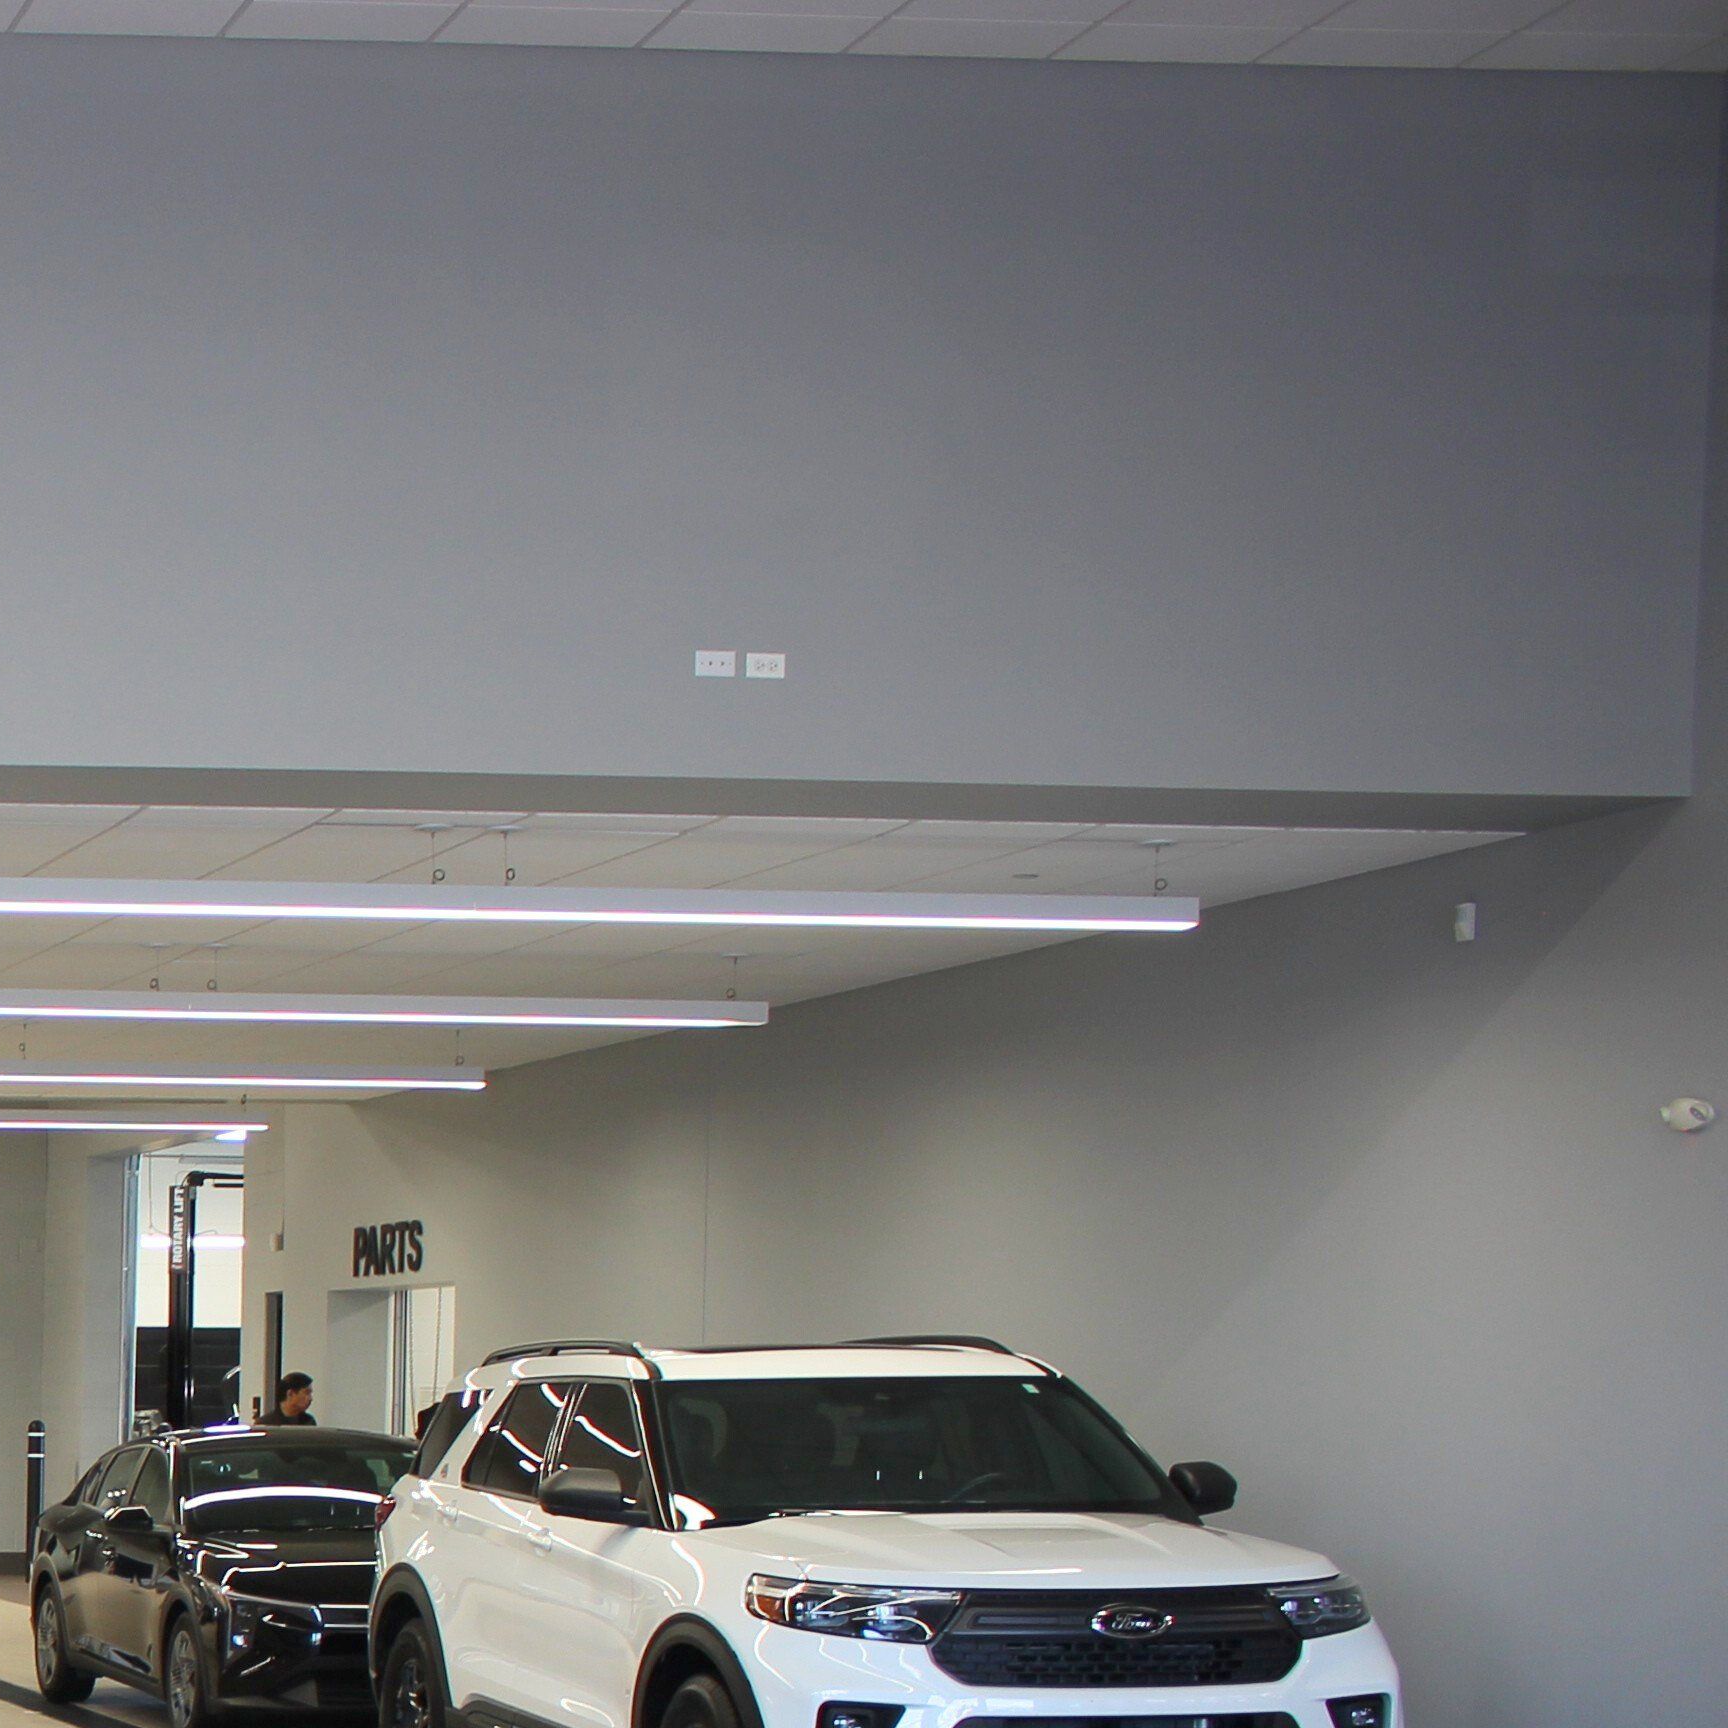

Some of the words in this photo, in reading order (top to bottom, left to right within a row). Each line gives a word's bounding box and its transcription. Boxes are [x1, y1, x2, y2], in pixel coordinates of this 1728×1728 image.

[172, 1186, 186, 1214] LIFT
[171, 1215, 185, 1264] ROTARY
[352, 1219, 424, 1277] PARTS
